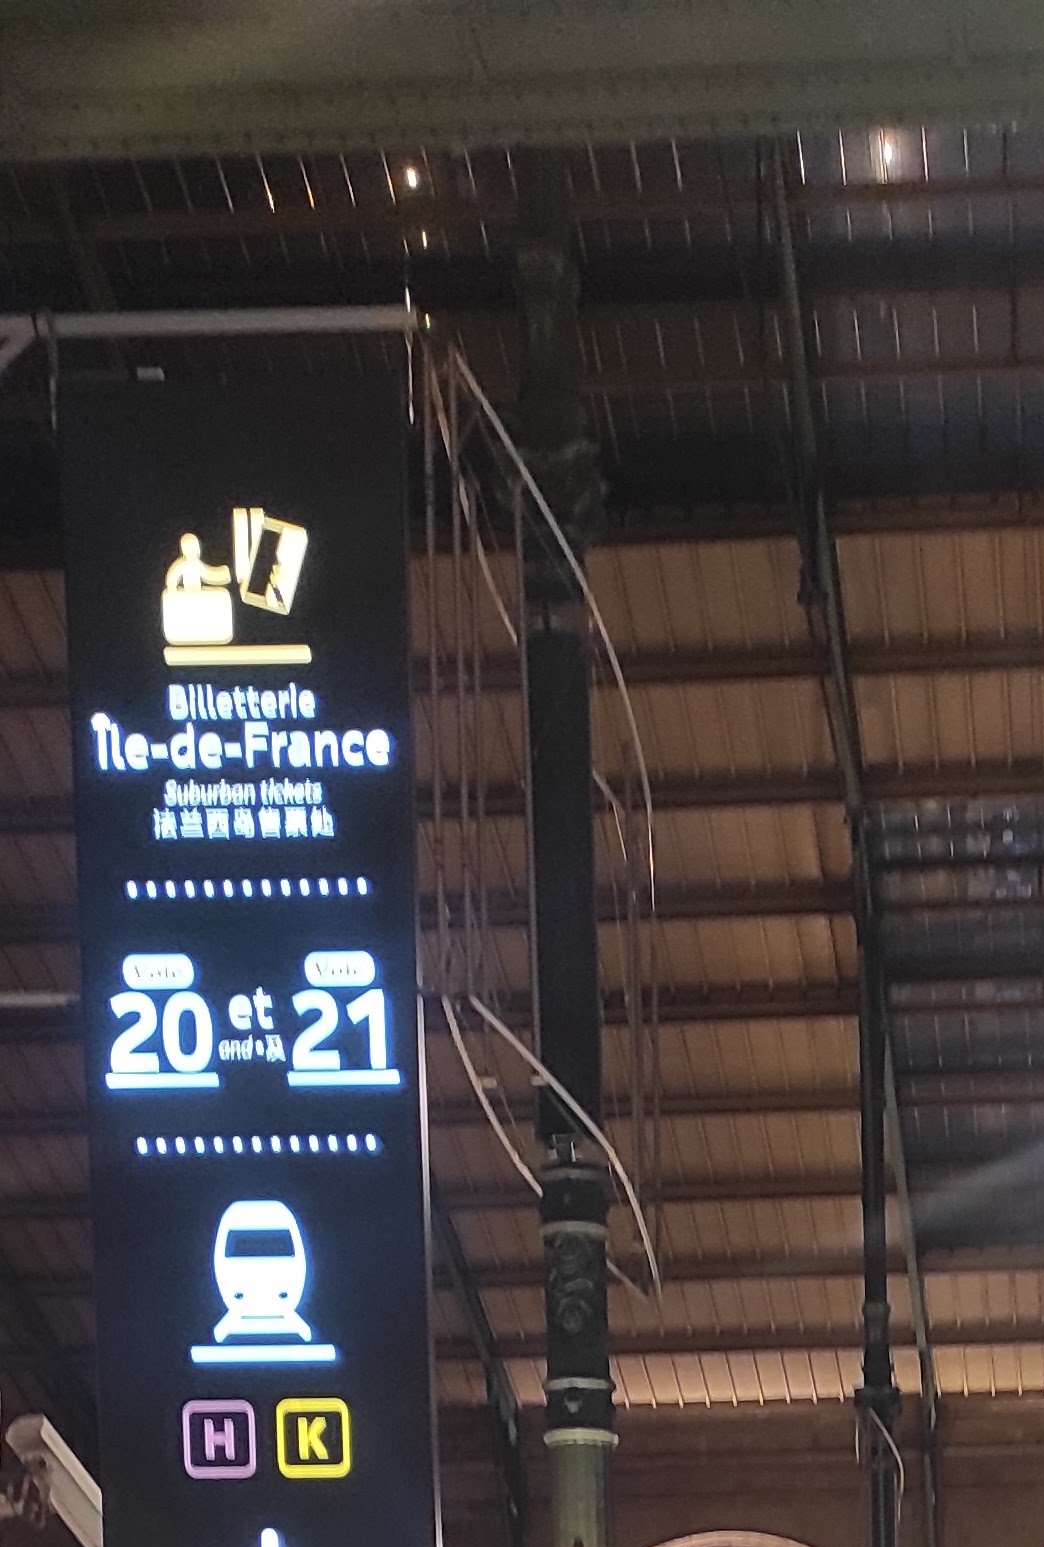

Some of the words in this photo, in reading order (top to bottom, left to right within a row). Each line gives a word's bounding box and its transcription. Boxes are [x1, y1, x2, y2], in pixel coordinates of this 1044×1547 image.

[166, 681, 317, 721] Billetterie
[259, 776, 323, 806] tickets
[227, 984, 275, 1031] et
[291, 988, 388, 1072] 21
[108, 990, 215, 1073] 20
[202, 1417, 236, 1462] H
[296, 1415, 329, 1461] K
